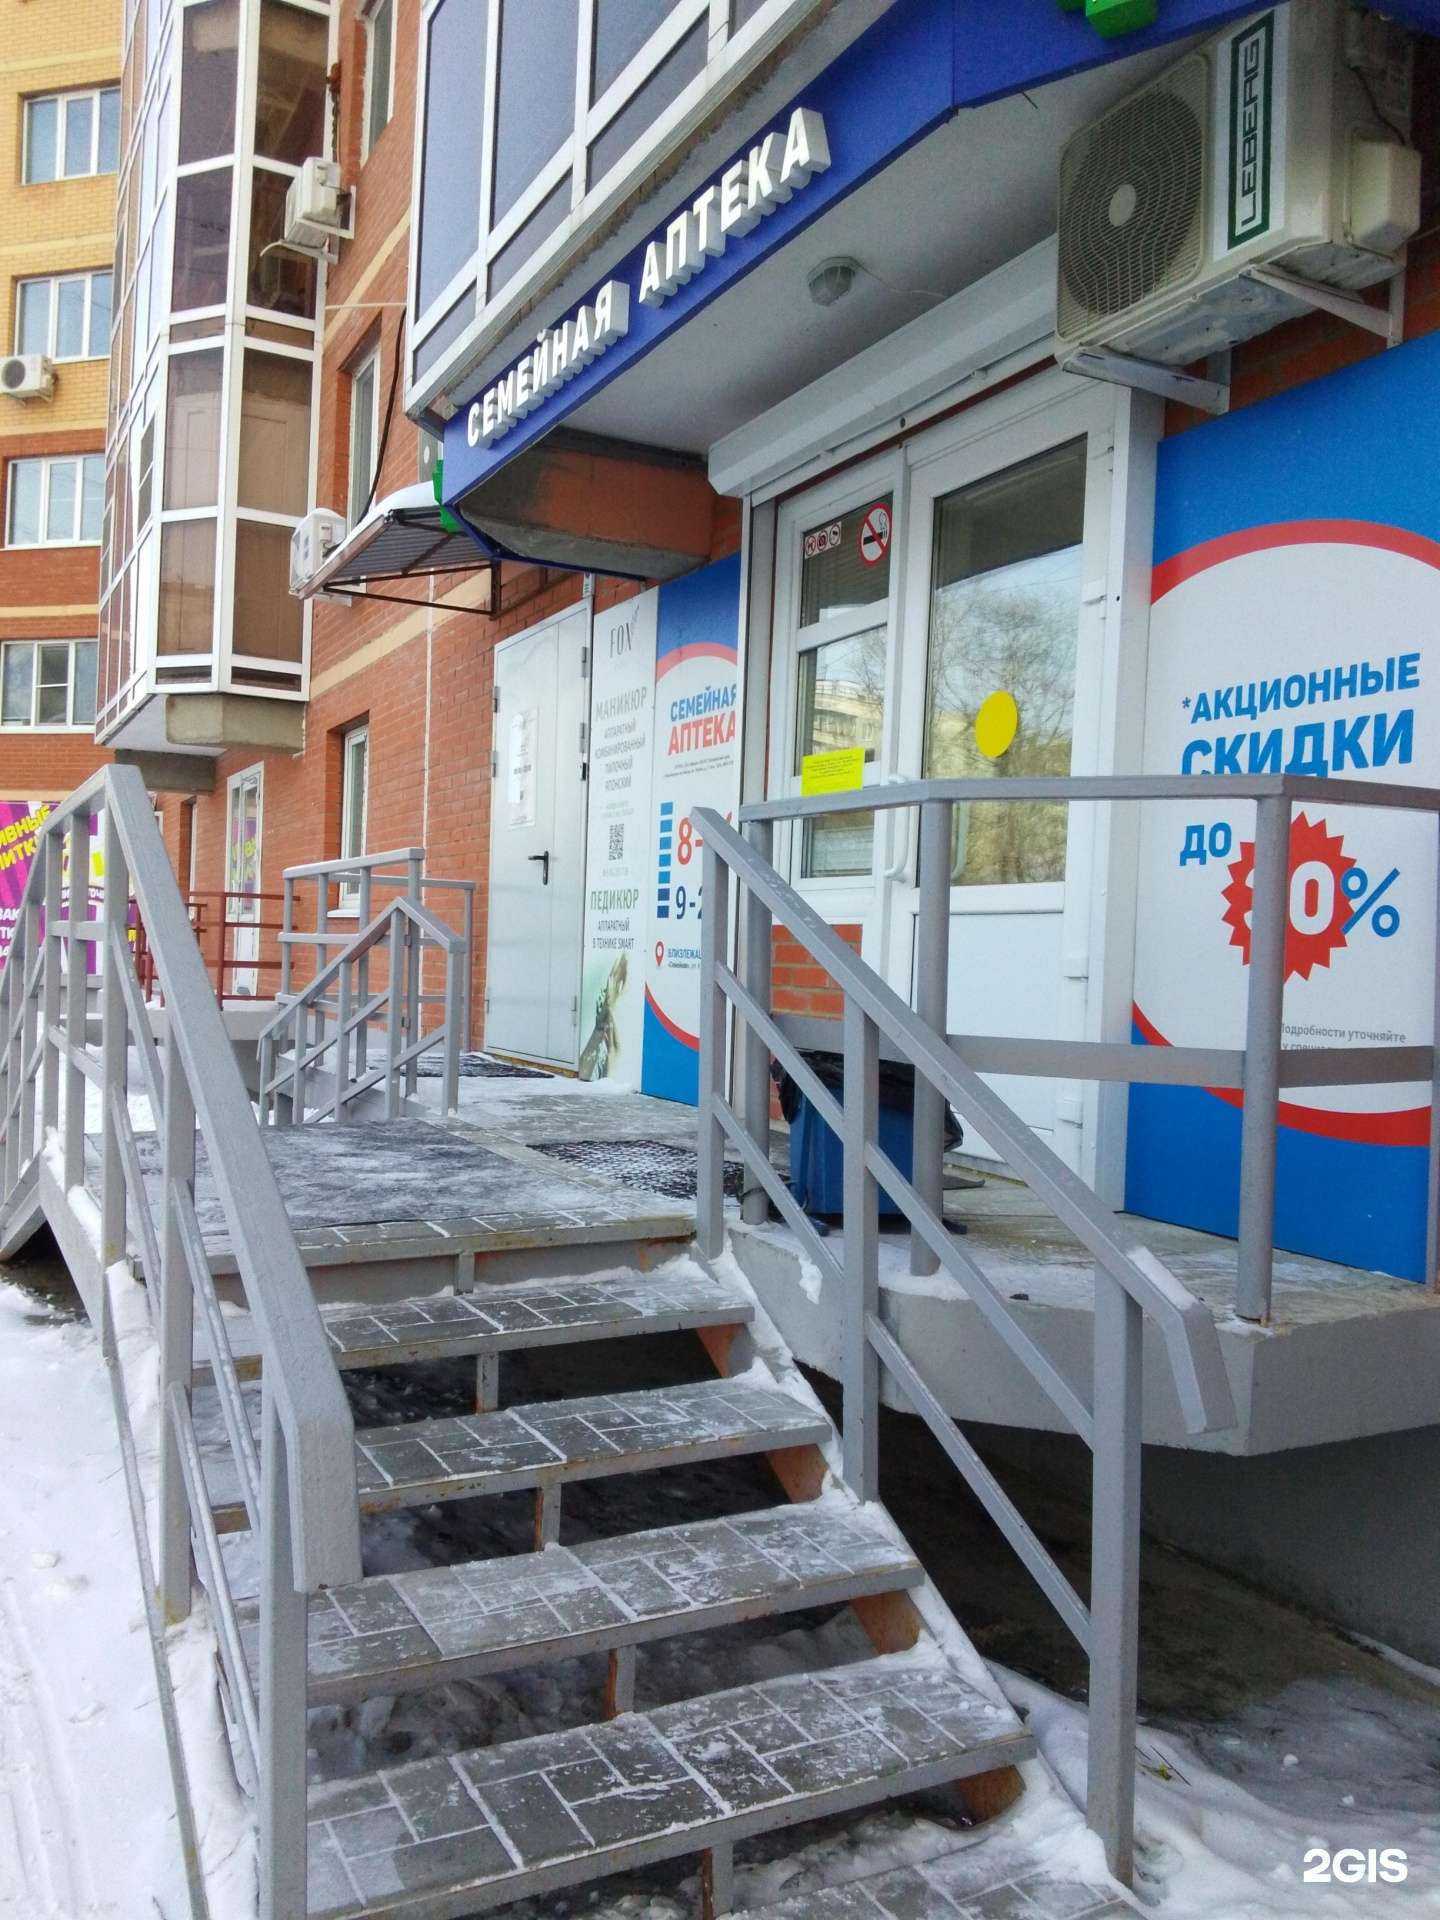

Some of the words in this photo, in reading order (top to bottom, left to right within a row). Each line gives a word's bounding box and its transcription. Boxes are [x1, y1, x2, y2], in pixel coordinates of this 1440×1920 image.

[1241, 37, 1260, 227] LEBERG
[467, 280, 630, 449] СЕМЕЙНАЯ
[638, 107, 831, 308] АПТЕКА
[595, 686, 647, 721] МАНИКЮР
[668, 710, 736, 756] АПТЕКА
[1181, 708, 1414, 778] СКИДКИ
[1179, 822, 1232, 866] ДО
[590, 888, 640, 914] ПЕДИКЮР
[1244, 861, 1400, 938] 0%
[1347, 1029, 1407, 1044] уточняйте
